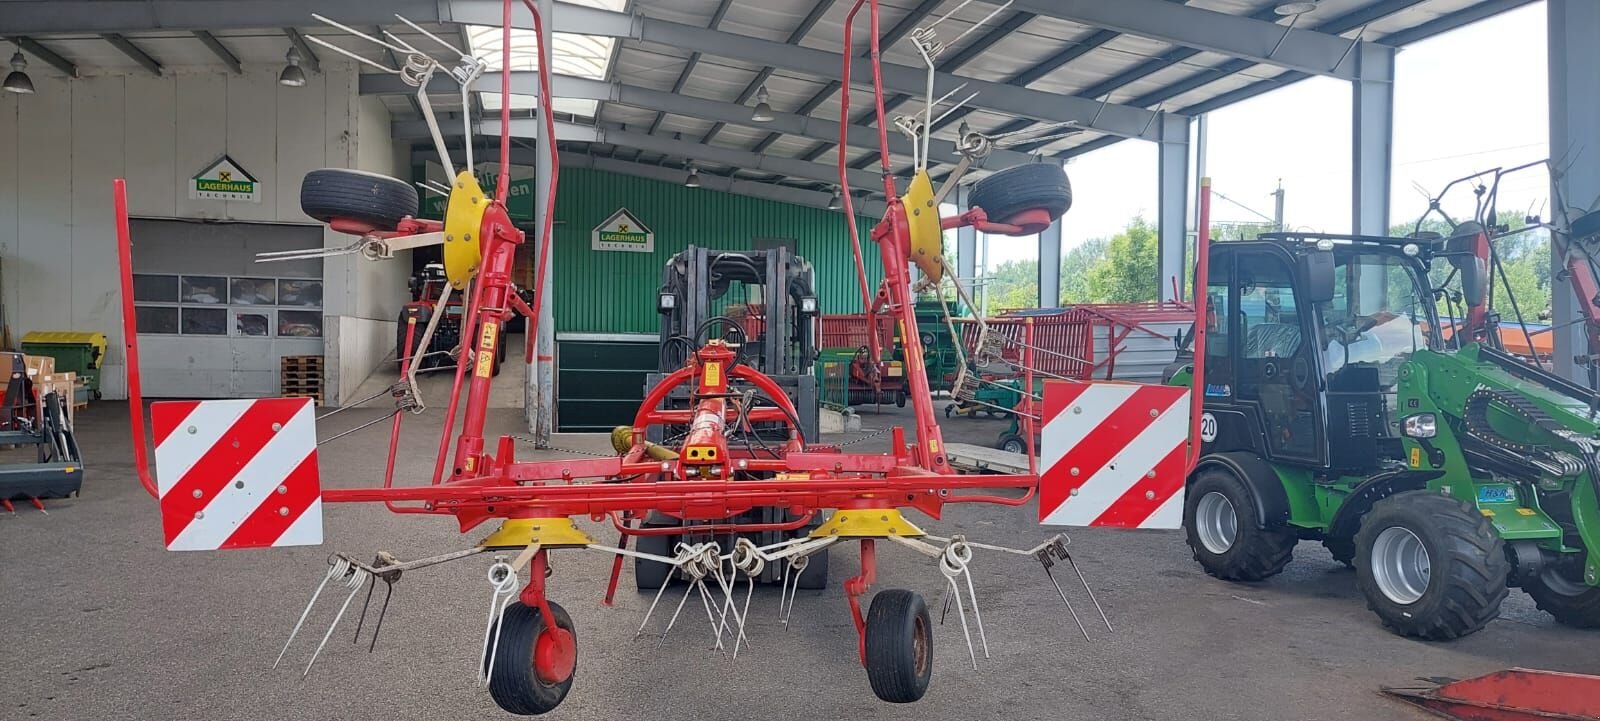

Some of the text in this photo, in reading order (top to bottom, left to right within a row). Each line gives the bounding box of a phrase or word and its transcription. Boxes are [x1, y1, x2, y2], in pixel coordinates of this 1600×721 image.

[199, 182, 251, 192] LAGERHAUS
[601, 234, 646, 242] LAGERHAUS
[1201, 418, 1215, 437] 20
